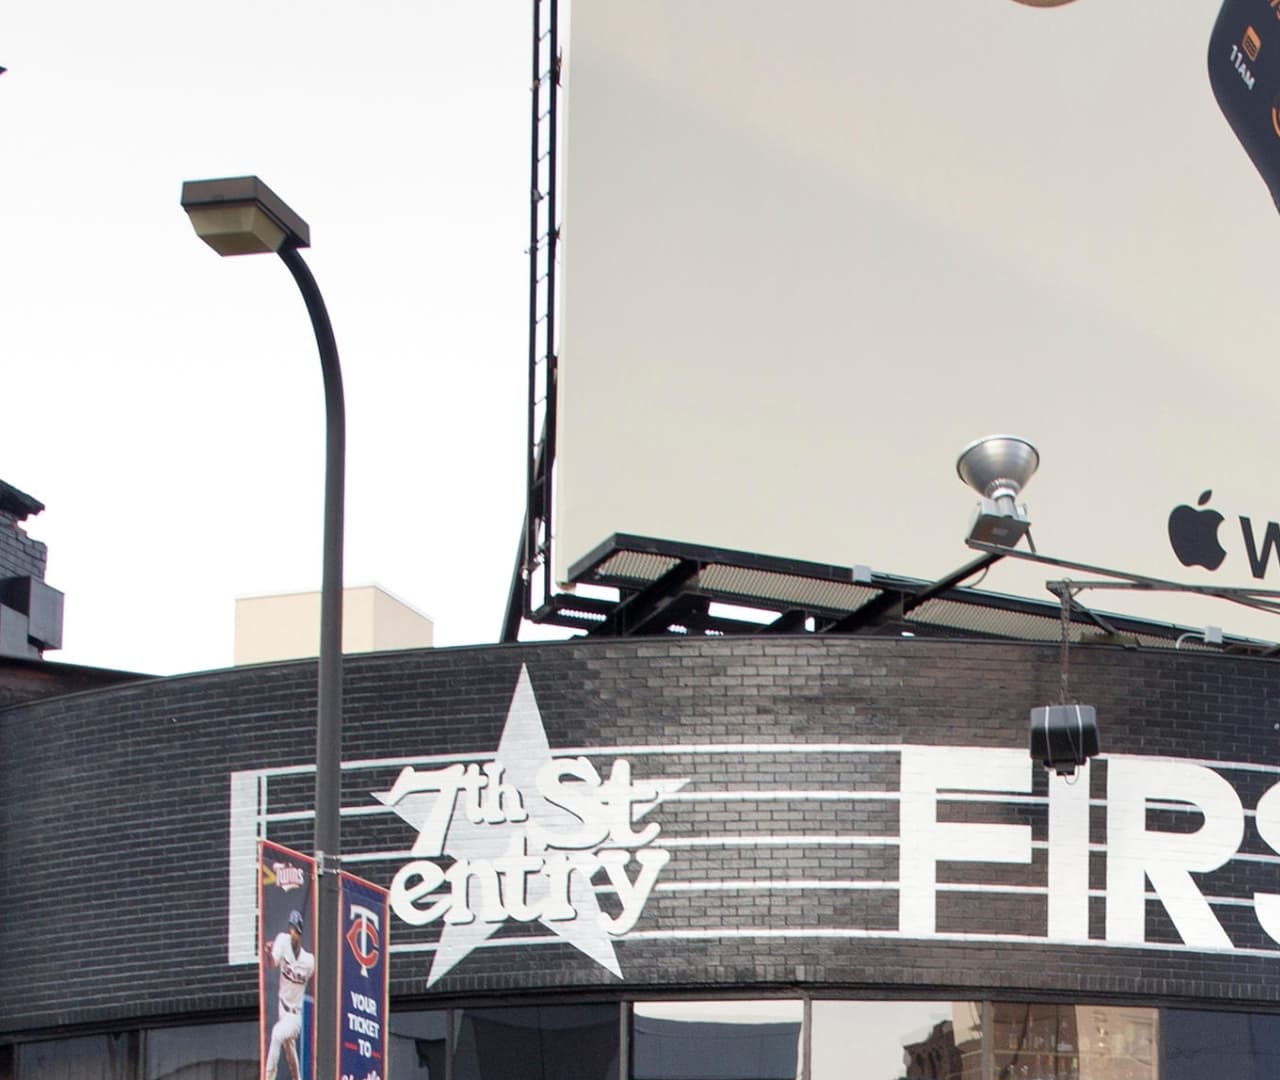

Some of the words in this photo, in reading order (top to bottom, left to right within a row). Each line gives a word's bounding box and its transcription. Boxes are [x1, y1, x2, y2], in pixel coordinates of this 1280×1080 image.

[1230, 44, 1257, 91] 11AM
[390, 760, 529, 858] 7th
[534, 755, 663, 851] St
[388, 847, 670, 937] entry
[351, 991, 378, 1017] YOUR
[347, 1014, 381, 1040] TICKET
[358, 1039, 373, 1058] TO
